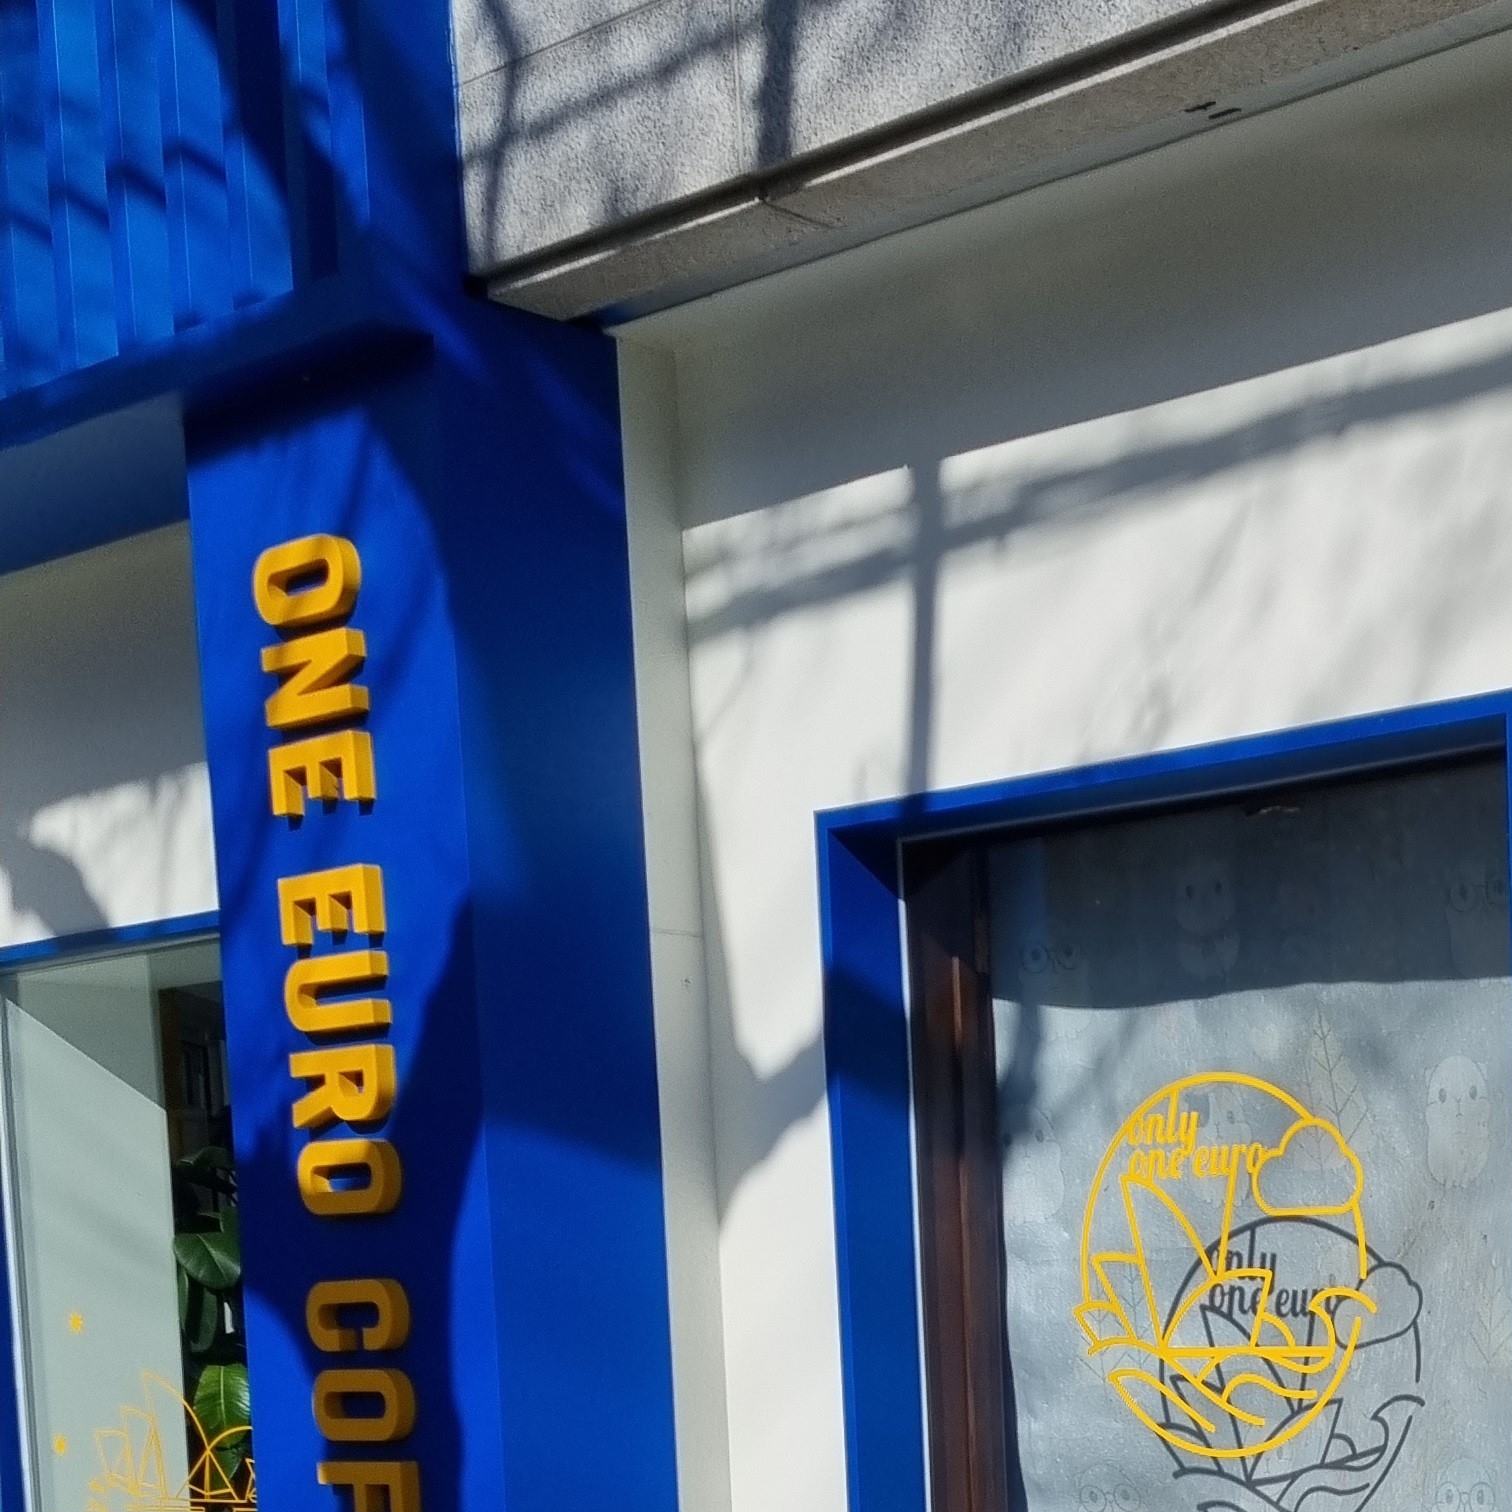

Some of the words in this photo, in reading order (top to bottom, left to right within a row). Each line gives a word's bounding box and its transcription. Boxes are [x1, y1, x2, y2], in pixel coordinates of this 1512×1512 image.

[252, 533, 377, 819] ONE
[277, 863, 402, 1215] EURO
[1127, 1090, 1199, 1157] only
[1128, 1146, 1184, 1180] one
[1192, 1142, 1265, 1180] euro
